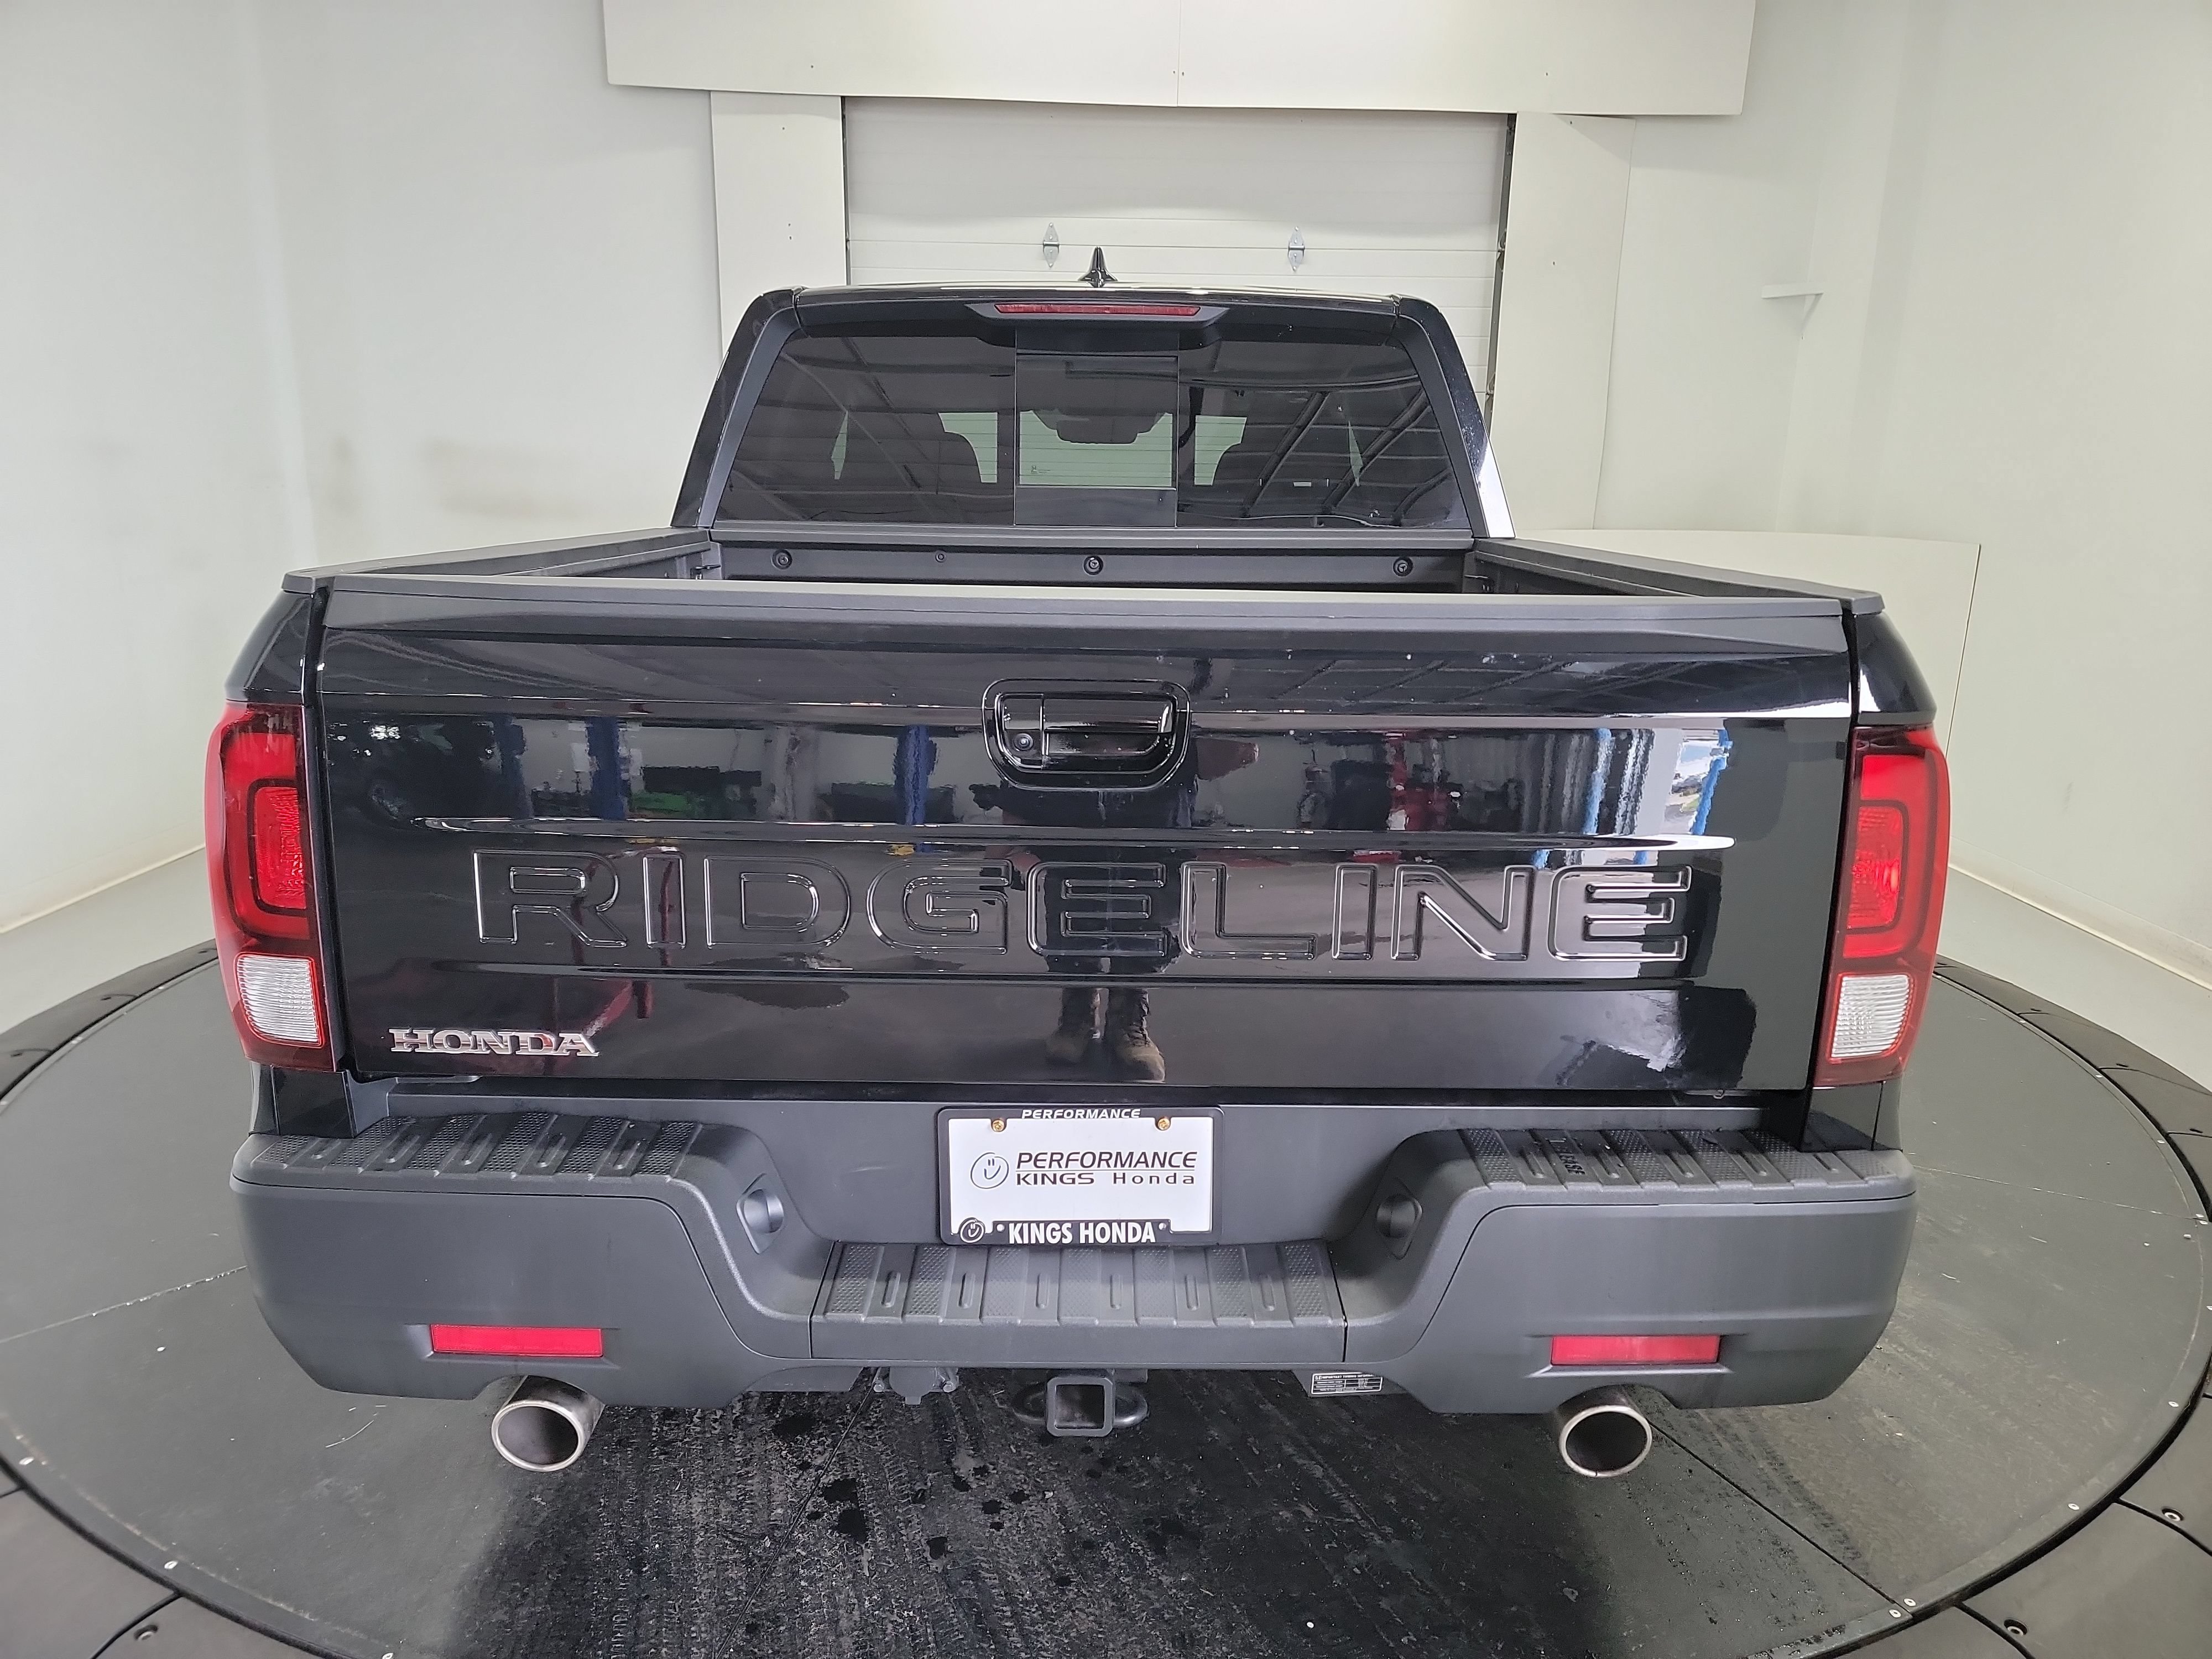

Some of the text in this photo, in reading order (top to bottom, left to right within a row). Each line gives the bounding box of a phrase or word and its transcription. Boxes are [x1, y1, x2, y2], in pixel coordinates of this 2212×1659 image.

[473, 849, 1692, 961] RIDGELINE
[388, 1029, 600, 1057] HONDA
[1021, 1109, 1141, 1119] PERFORMANCE
[1016, 1151, 1198, 1168] PERFORMANCE
[1016, 1172, 1195, 1185] KINGS Honda
[1009, 1222, 1156, 1244] KINGS HONDA
